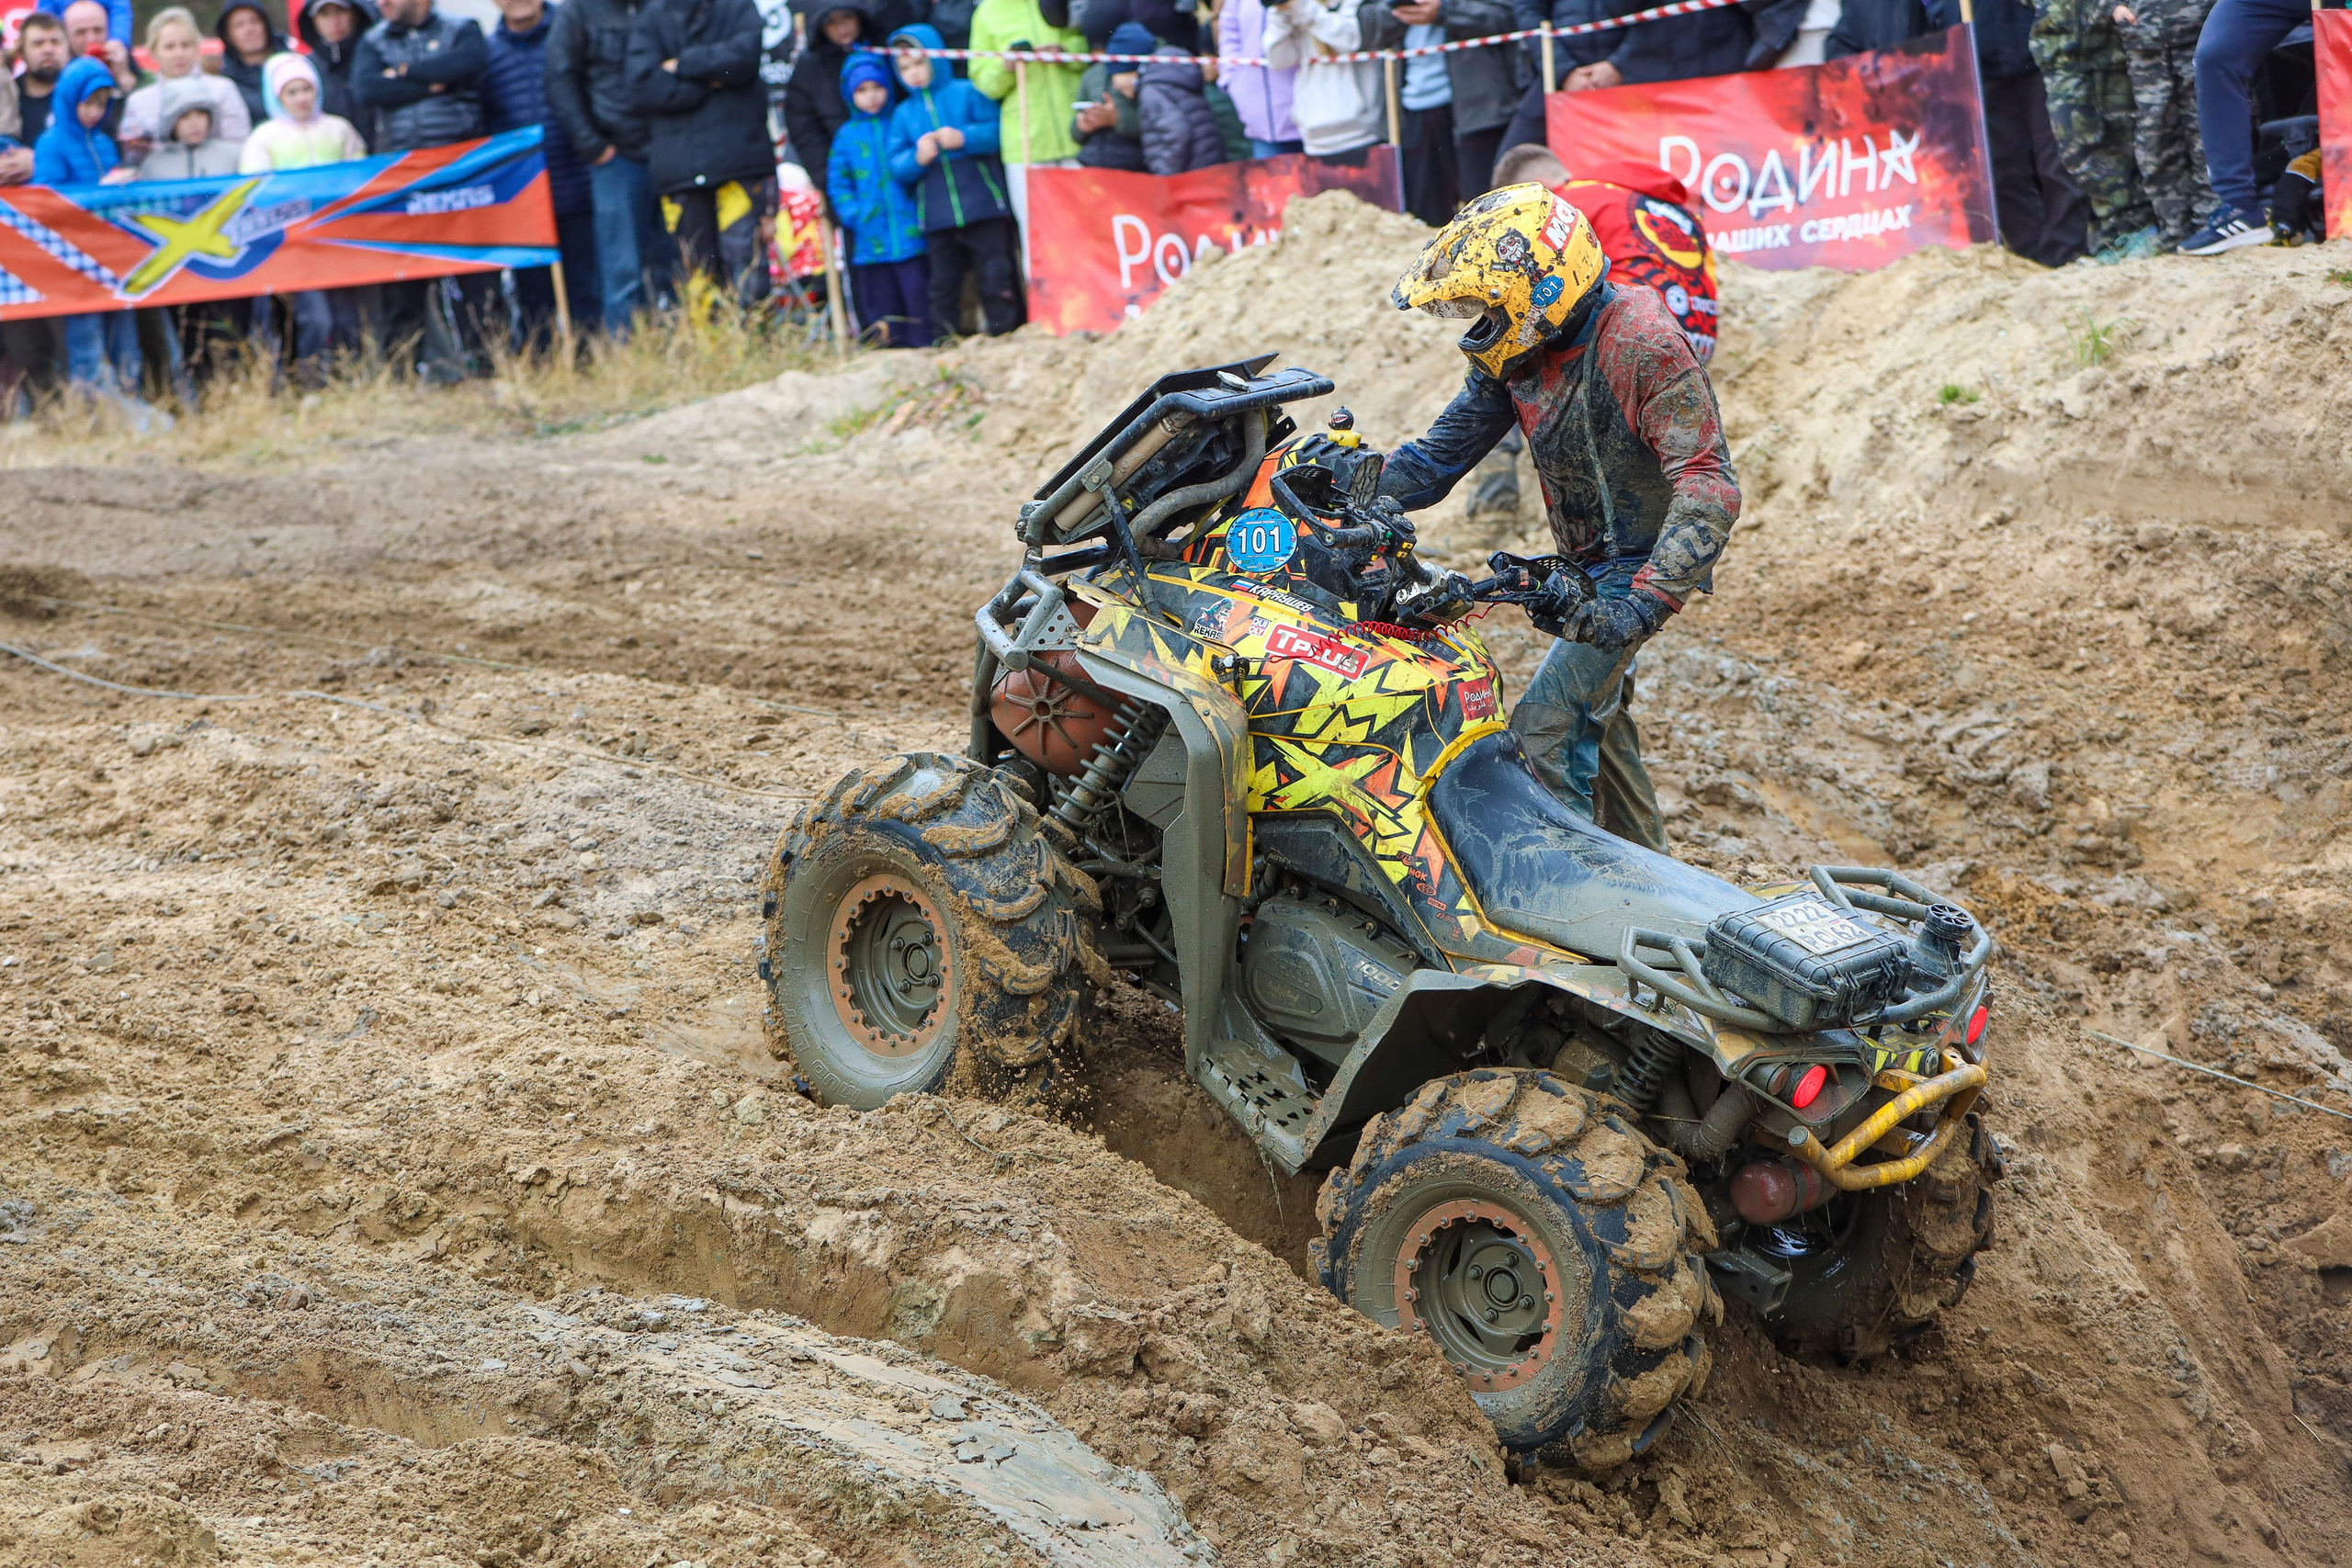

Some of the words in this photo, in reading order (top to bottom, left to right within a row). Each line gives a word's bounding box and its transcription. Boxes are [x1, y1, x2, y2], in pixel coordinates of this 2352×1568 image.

[1800, 204, 1913, 244] СЕРДЦАХ
[1536, 281, 1559, 302] 101
[1238, 525, 1280, 554] 101
[1250, 584, 1315, 612] КАРАУШЕВ
[1408, 867, 1427, 881] NGK
[1428, 899, 1445, 909] ROTAX
[1770, 905, 1828, 928] 2222
[1829, 923, 1869, 941] 62
[1352, 959, 1403, 991] 1000
[811, 1059, 862, 1102] MUD
